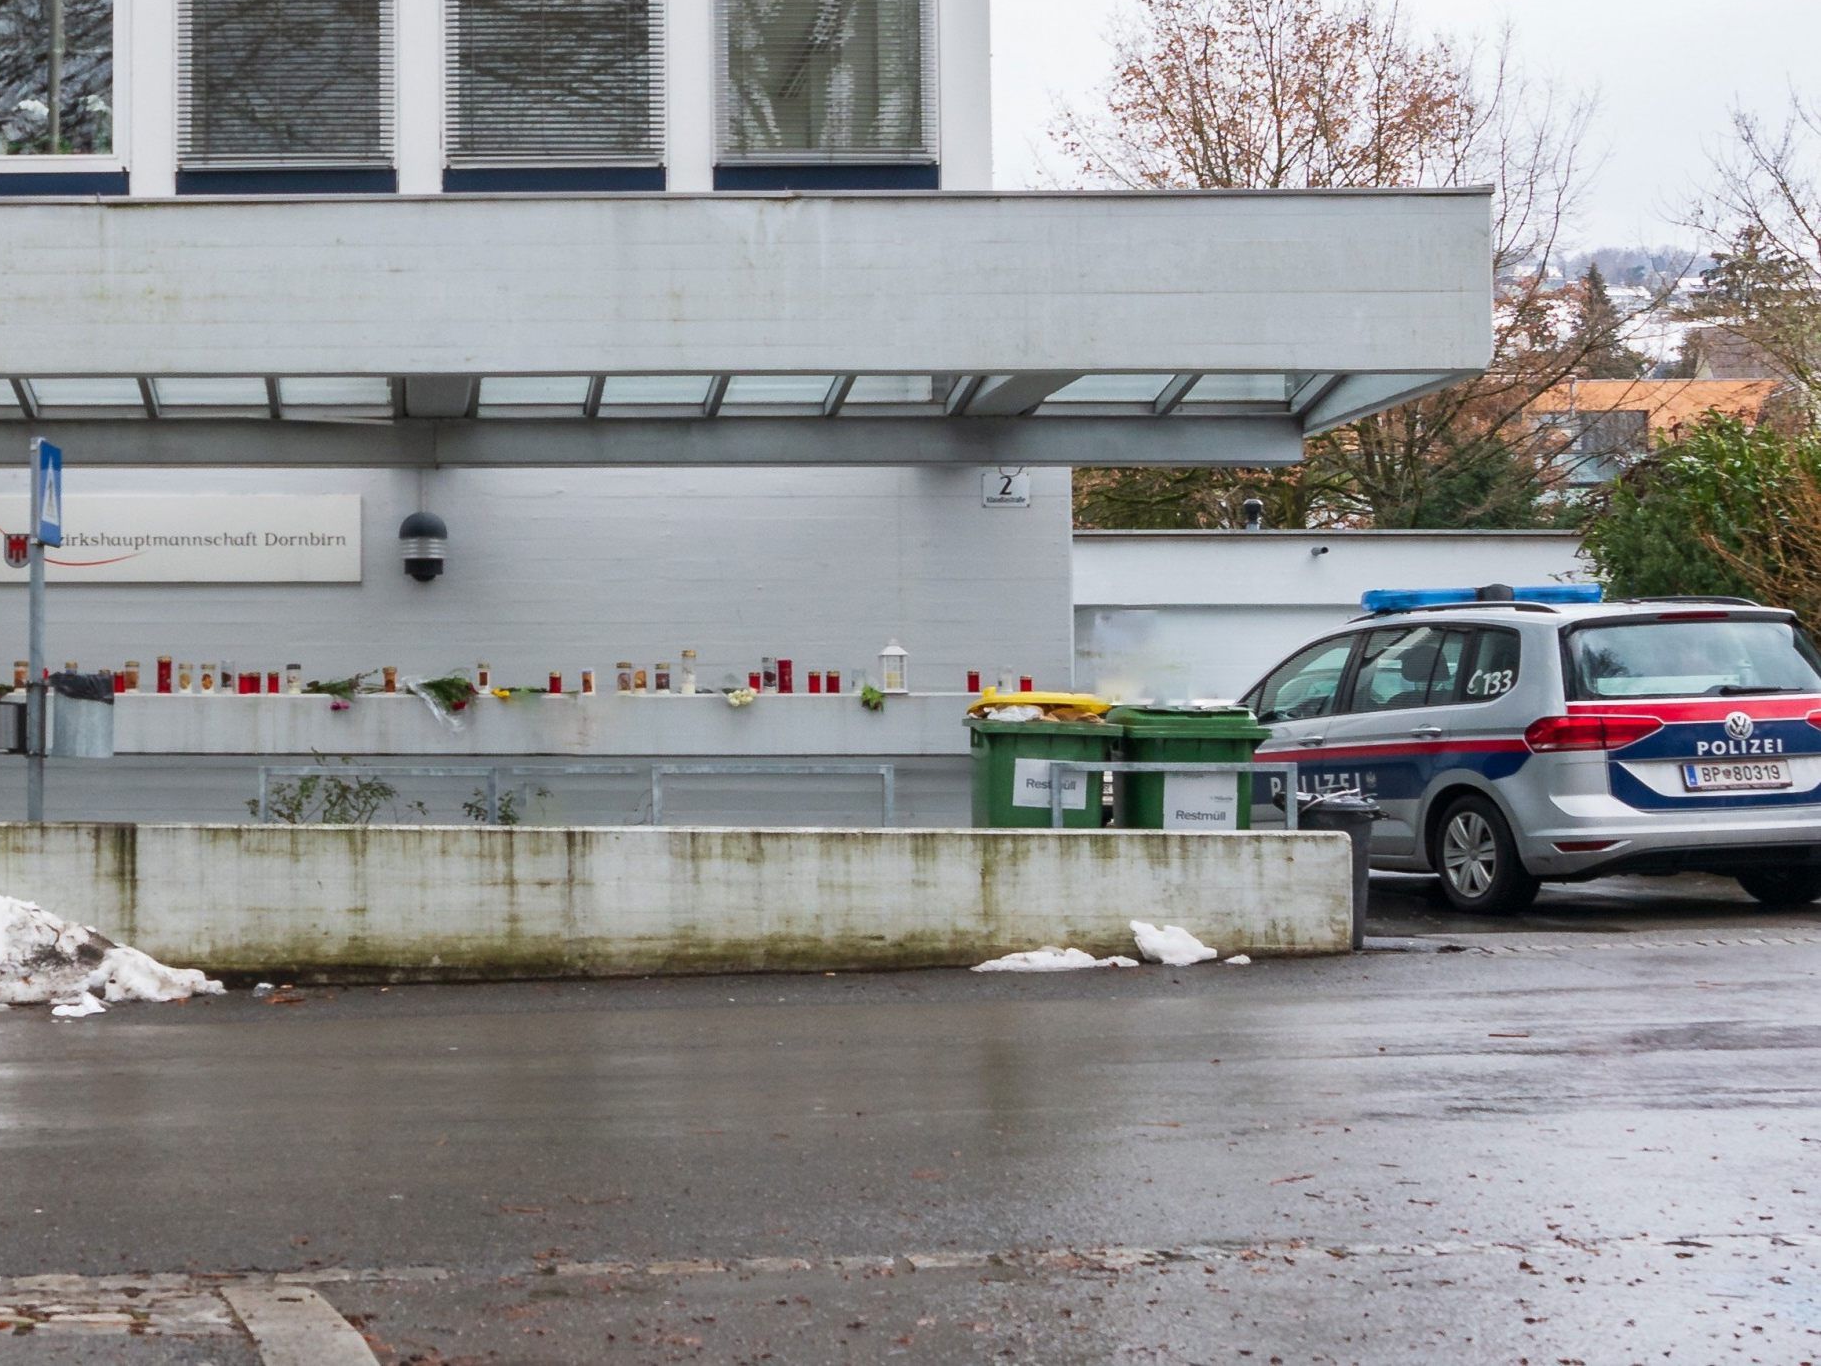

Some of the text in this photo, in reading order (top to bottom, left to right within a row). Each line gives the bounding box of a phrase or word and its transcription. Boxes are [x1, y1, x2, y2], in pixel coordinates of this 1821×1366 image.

[999, 475, 1012, 495] 2
[59, 532, 346, 550] zirkshauptmannschaft Dornbirn
[1482, 669, 1513, 695] 133
[1696, 738, 1783, 756] POLIZEI
[1701, 764, 1781, 783] BP 80319
[1026, 778, 1077, 791] Restüll
[1175, 809, 1226, 821] Restmüll
